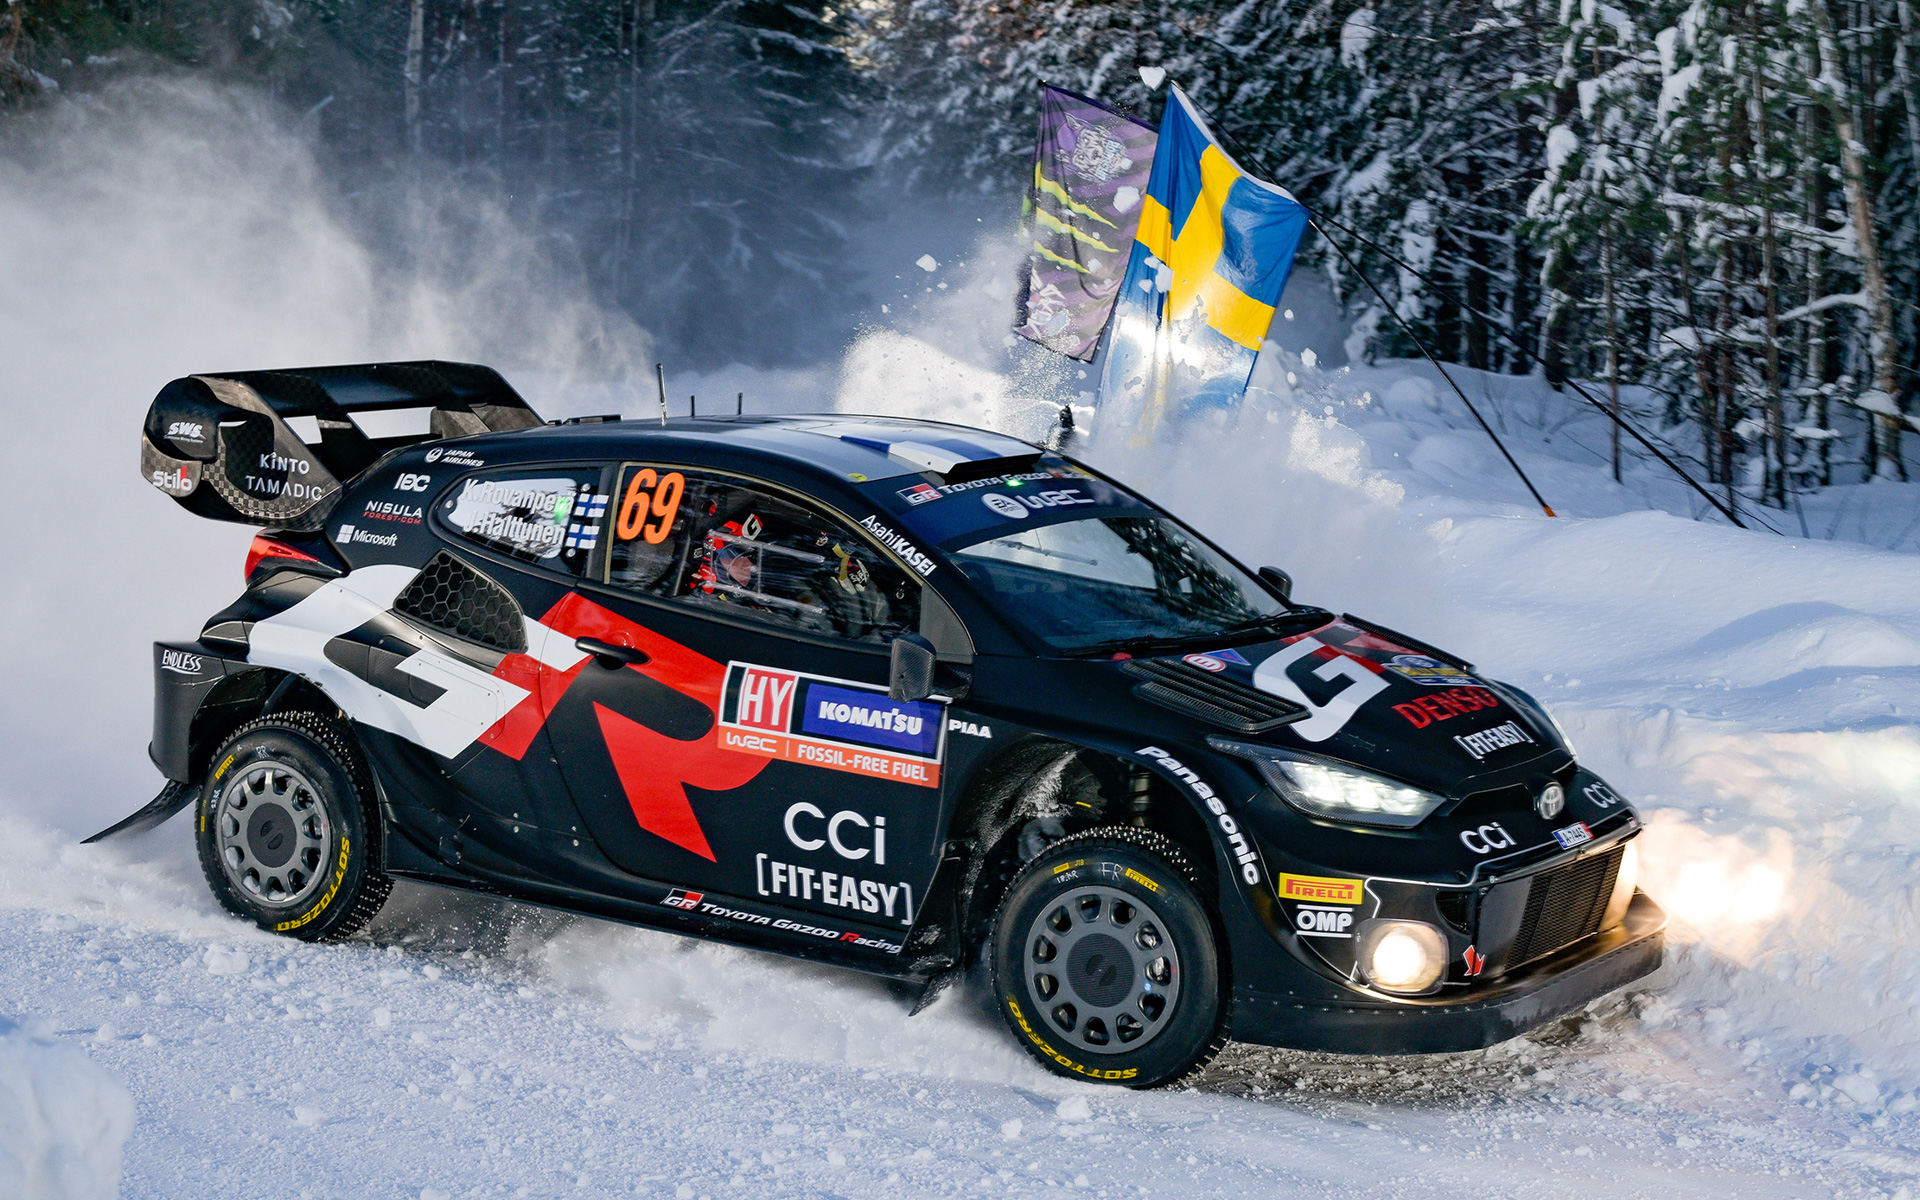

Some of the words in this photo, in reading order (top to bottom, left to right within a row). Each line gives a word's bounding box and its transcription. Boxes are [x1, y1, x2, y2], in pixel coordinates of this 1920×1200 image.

[167, 422, 205, 439] SWS
[441, 457, 485, 467] AIRLINES
[444, 449, 475, 458] JAPAN
[152, 465, 193, 491] Stilo
[245, 475, 323, 501] TAMADIC
[936, 477, 1004, 495] TOYOTA
[364, 500, 423, 518] NISULA
[616, 468, 686, 545] 69
[1015, 489, 1095, 509] WRC
[352, 529, 398, 547] Microsoft
[462, 511, 566, 545] J.Halttunen
[162, 649, 203, 672] ENDLESS
[740, 673, 794, 727] HY
[1391, 686, 1499, 729] DENSO
[818, 701, 923, 736] KOMATSU
[949, 719, 993, 739] PIAA
[726, 731, 778, 753] WRC
[797, 743, 889, 775] FOSSIL-FREE
[892, 761, 930, 782] FUEL
[1582, 781, 1621, 809] CCi
[1134, 745, 1261, 886] Panasonic
[783, 801, 886, 866] CCi
[1459, 821, 1517, 855] CCi
[277, 836, 350, 932] SOTTOZERO
[1285, 878, 1355, 900] PIRELLI
[701, 902, 772, 925] TOYOTA
[771, 918, 840, 940] GAZOO
[839, 931, 903, 955] Racing
[1296, 910, 1354, 932] OMP
[1008, 1000, 1139, 1080] SOTTOZERO
